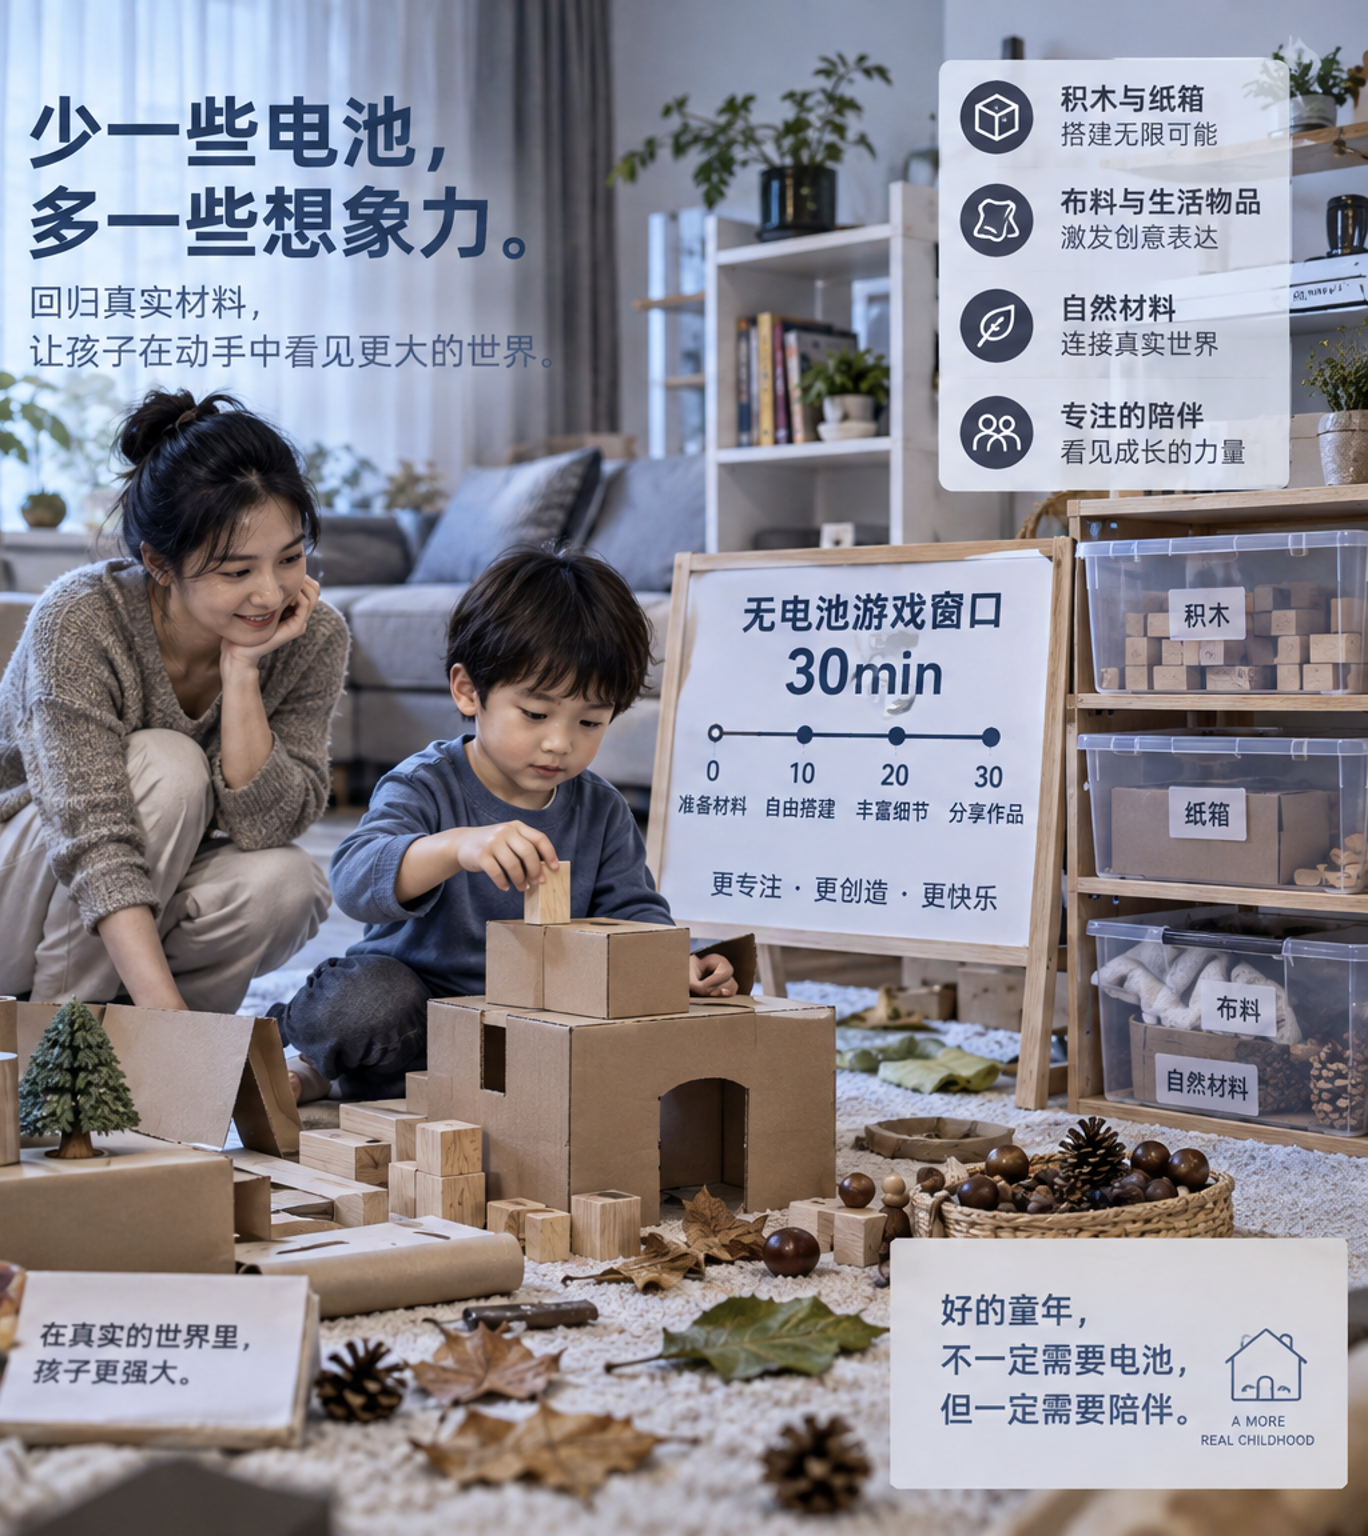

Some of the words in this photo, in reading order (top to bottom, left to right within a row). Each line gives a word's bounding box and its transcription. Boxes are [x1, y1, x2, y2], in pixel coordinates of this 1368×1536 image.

[1184, 602, 1230, 629] 积木
[706, 759, 720, 782] 0
[790, 762, 815, 784] 10
[880, 763, 909, 787] 20
[974, 765, 1003, 789] 30
[678, 794, 748, 817] 准备材料
[765, 796, 836, 820] 自由搭建
[855, 798, 930, 823] 丰富细节
[948, 801, 1024, 825] 分享作品
[1184, 800, 1230, 828] 纸箱
[710, 871, 783, 899] 更专注
[814, 876, 889, 906] 更创造
[921, 882, 998, 912] 更快乐
[1216, 995, 1261, 1024] 布料
[1167, 1068, 1249, 1102] 自然材料
[40, 1321, 250, 1351] 在真实的世界里，
[33, 1358, 189, 1386] 孩子更强大。
